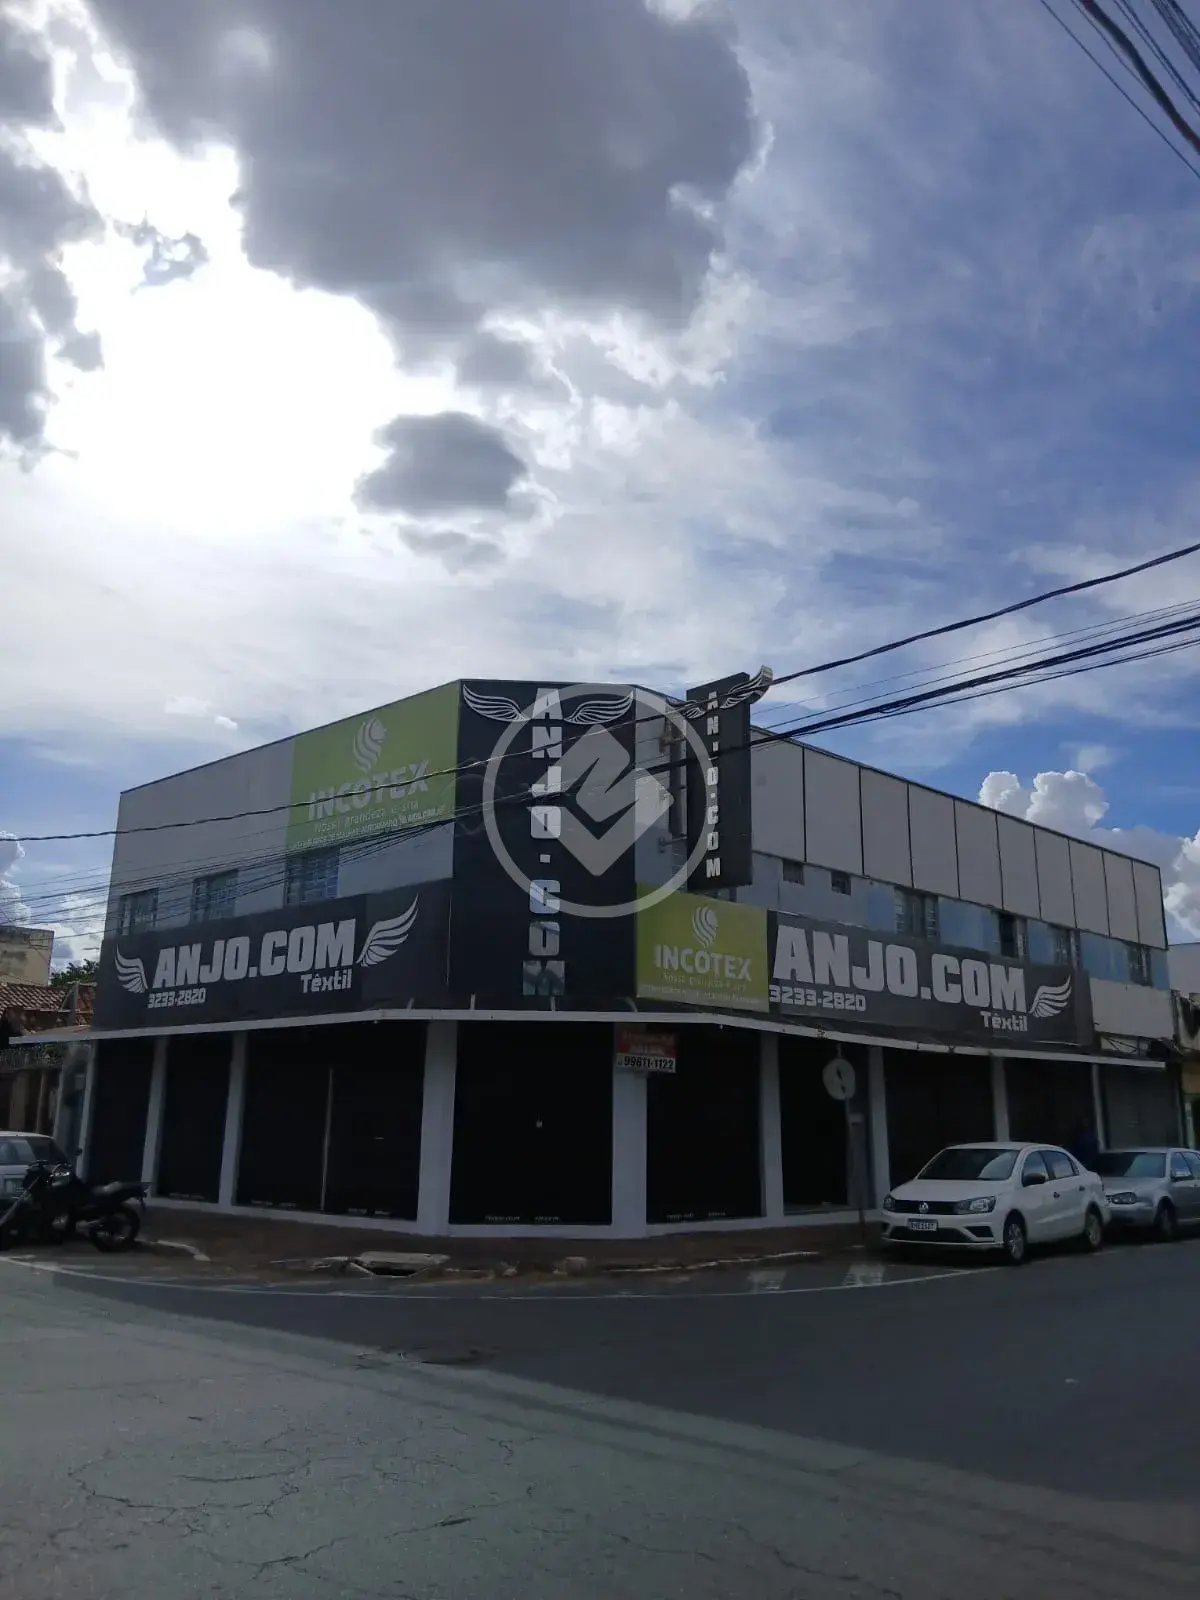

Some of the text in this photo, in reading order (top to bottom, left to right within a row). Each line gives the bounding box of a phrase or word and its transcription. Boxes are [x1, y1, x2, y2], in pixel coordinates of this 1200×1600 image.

[308, 759, 430, 820] INCOTEX
[522, 688, 565, 995] ANJO.COM
[152, 919, 356, 989] ANJO.COM
[654, 944, 752, 982] INCOTEX
[773, 926, 1026, 1012] ANJO.COM
[147, 988, 206, 1008] 3233-2820
[300, 968, 352, 993] Têxtil
[768, 984, 867, 1012] 3233-2820
[980, 1011, 1028, 1032] Têxtil
